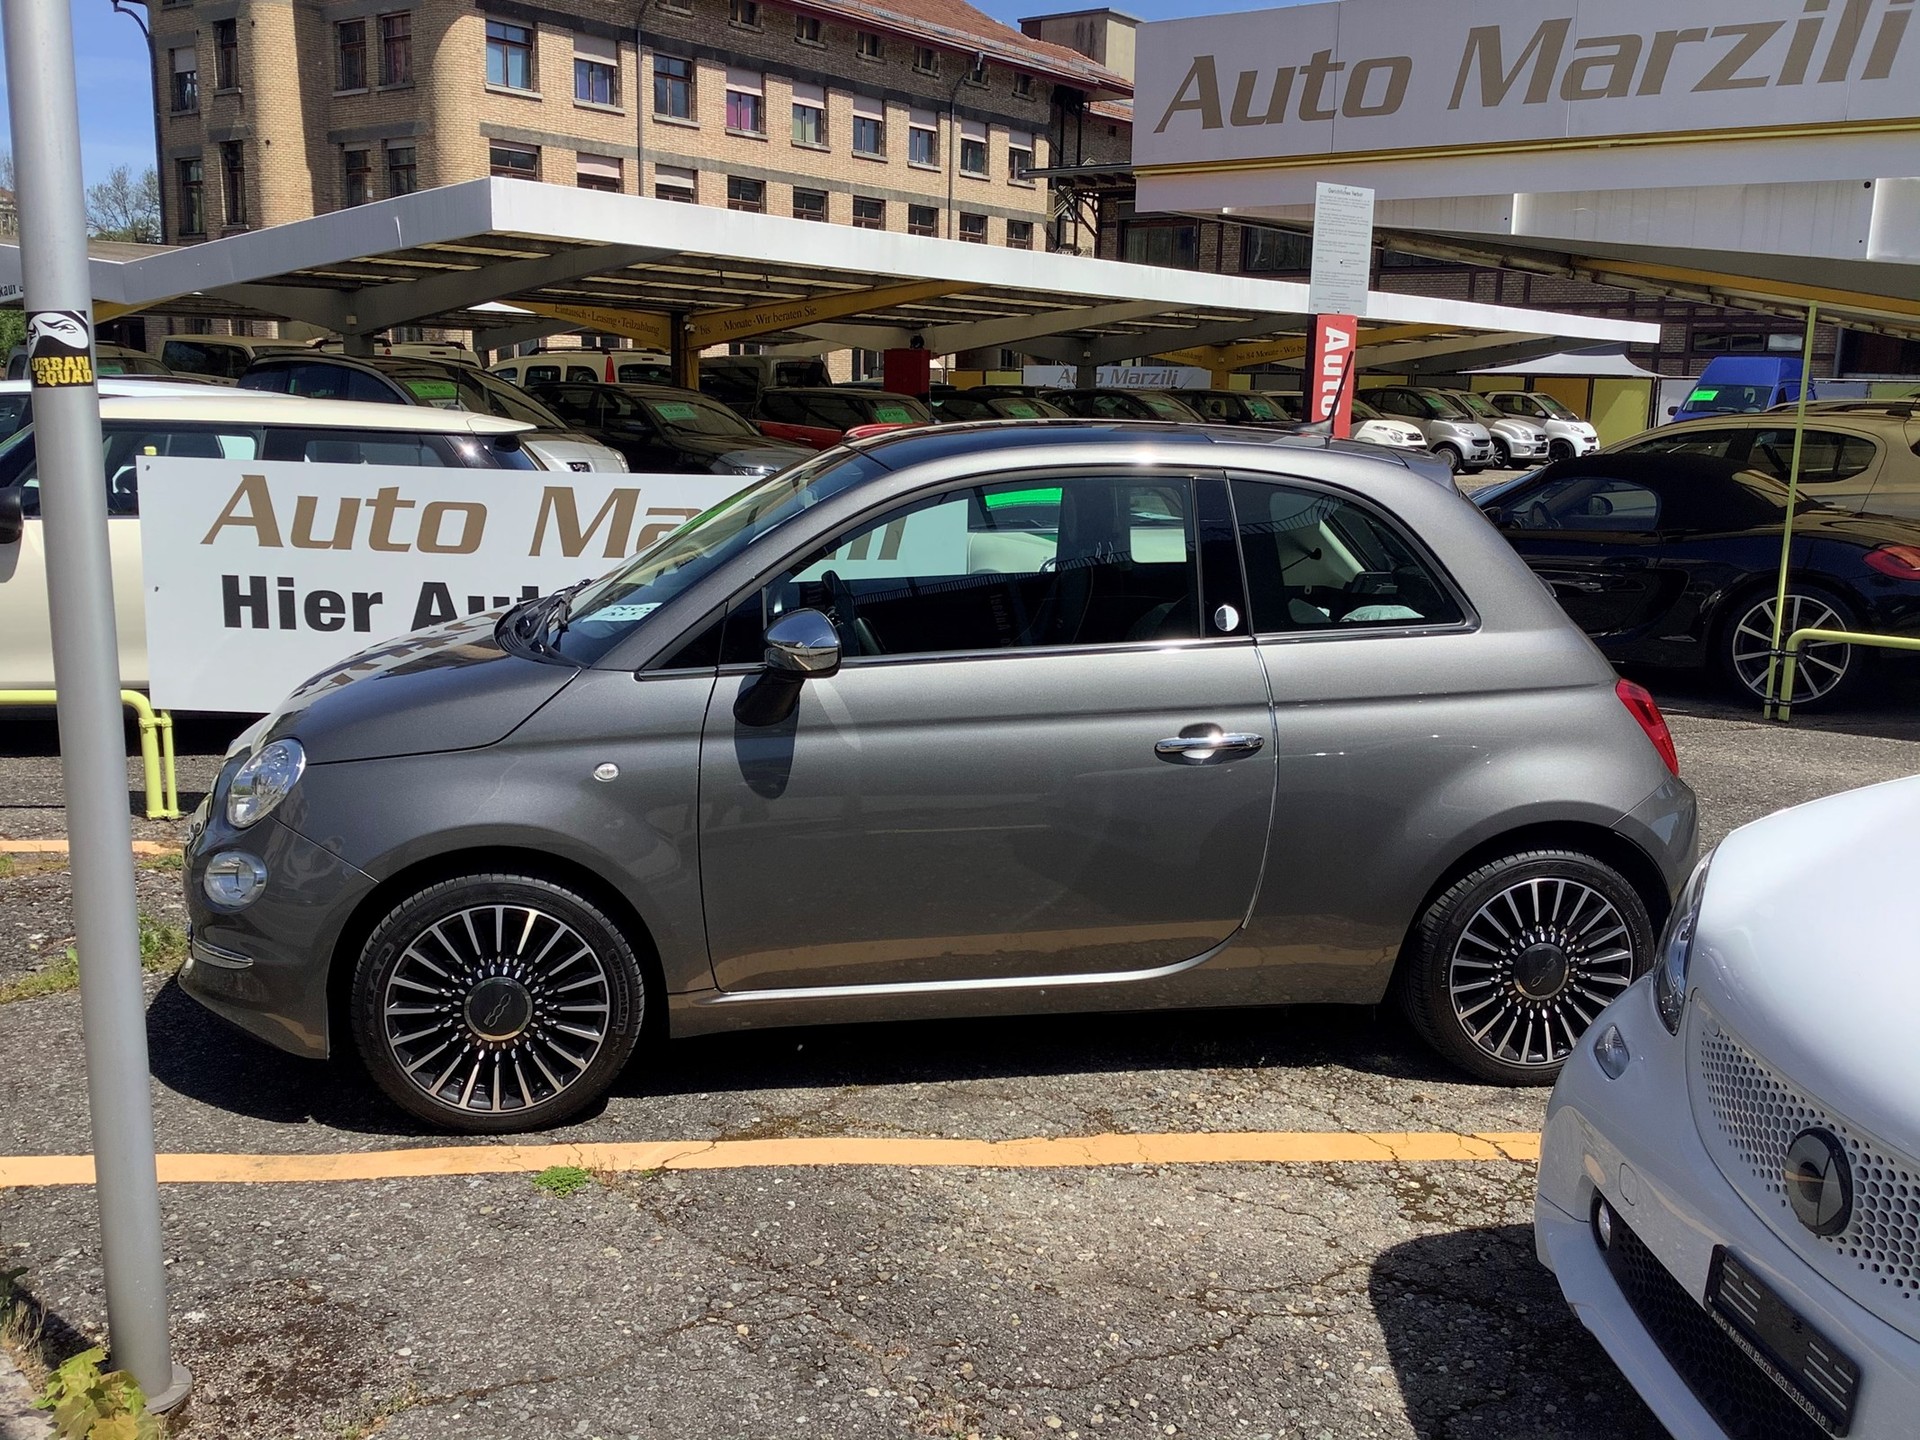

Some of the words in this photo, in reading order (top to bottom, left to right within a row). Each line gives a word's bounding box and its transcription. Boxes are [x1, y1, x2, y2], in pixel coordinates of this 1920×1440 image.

[1153, 48, 1413, 134] Auto
[1447, 0, 1918, 110] Marzili
[591, 311, 618, 329] Leasing
[621, 317, 660, 337] Teilzahlung
[723, 317, 752, 332] Monate
[754, 312, 771, 326] Wir
[772, 308, 802, 322] beraten
[804, 304, 817, 317] Sie
[31, 356, 89, 371] URBAN
[37, 369, 93, 387] SQUAD
[1111, 368, 1179, 385] Marzili
[1321, 327, 1350, 417] Auto
[200, 474, 487, 555] Auto
[222, 574, 383, 633] Hier
[1711, 1310, 1728, 1331] Auto
[1728, 1326, 1753, 1356] Marzili
[1754, 1351, 1773, 1375] Bern
[1775, 1371, 1788, 1390] 031
[1791, 1387, 1805, 1406] 318
[1805, 1401, 1816, 1416] 00
[1816, 1411, 1827, 1427] 18
